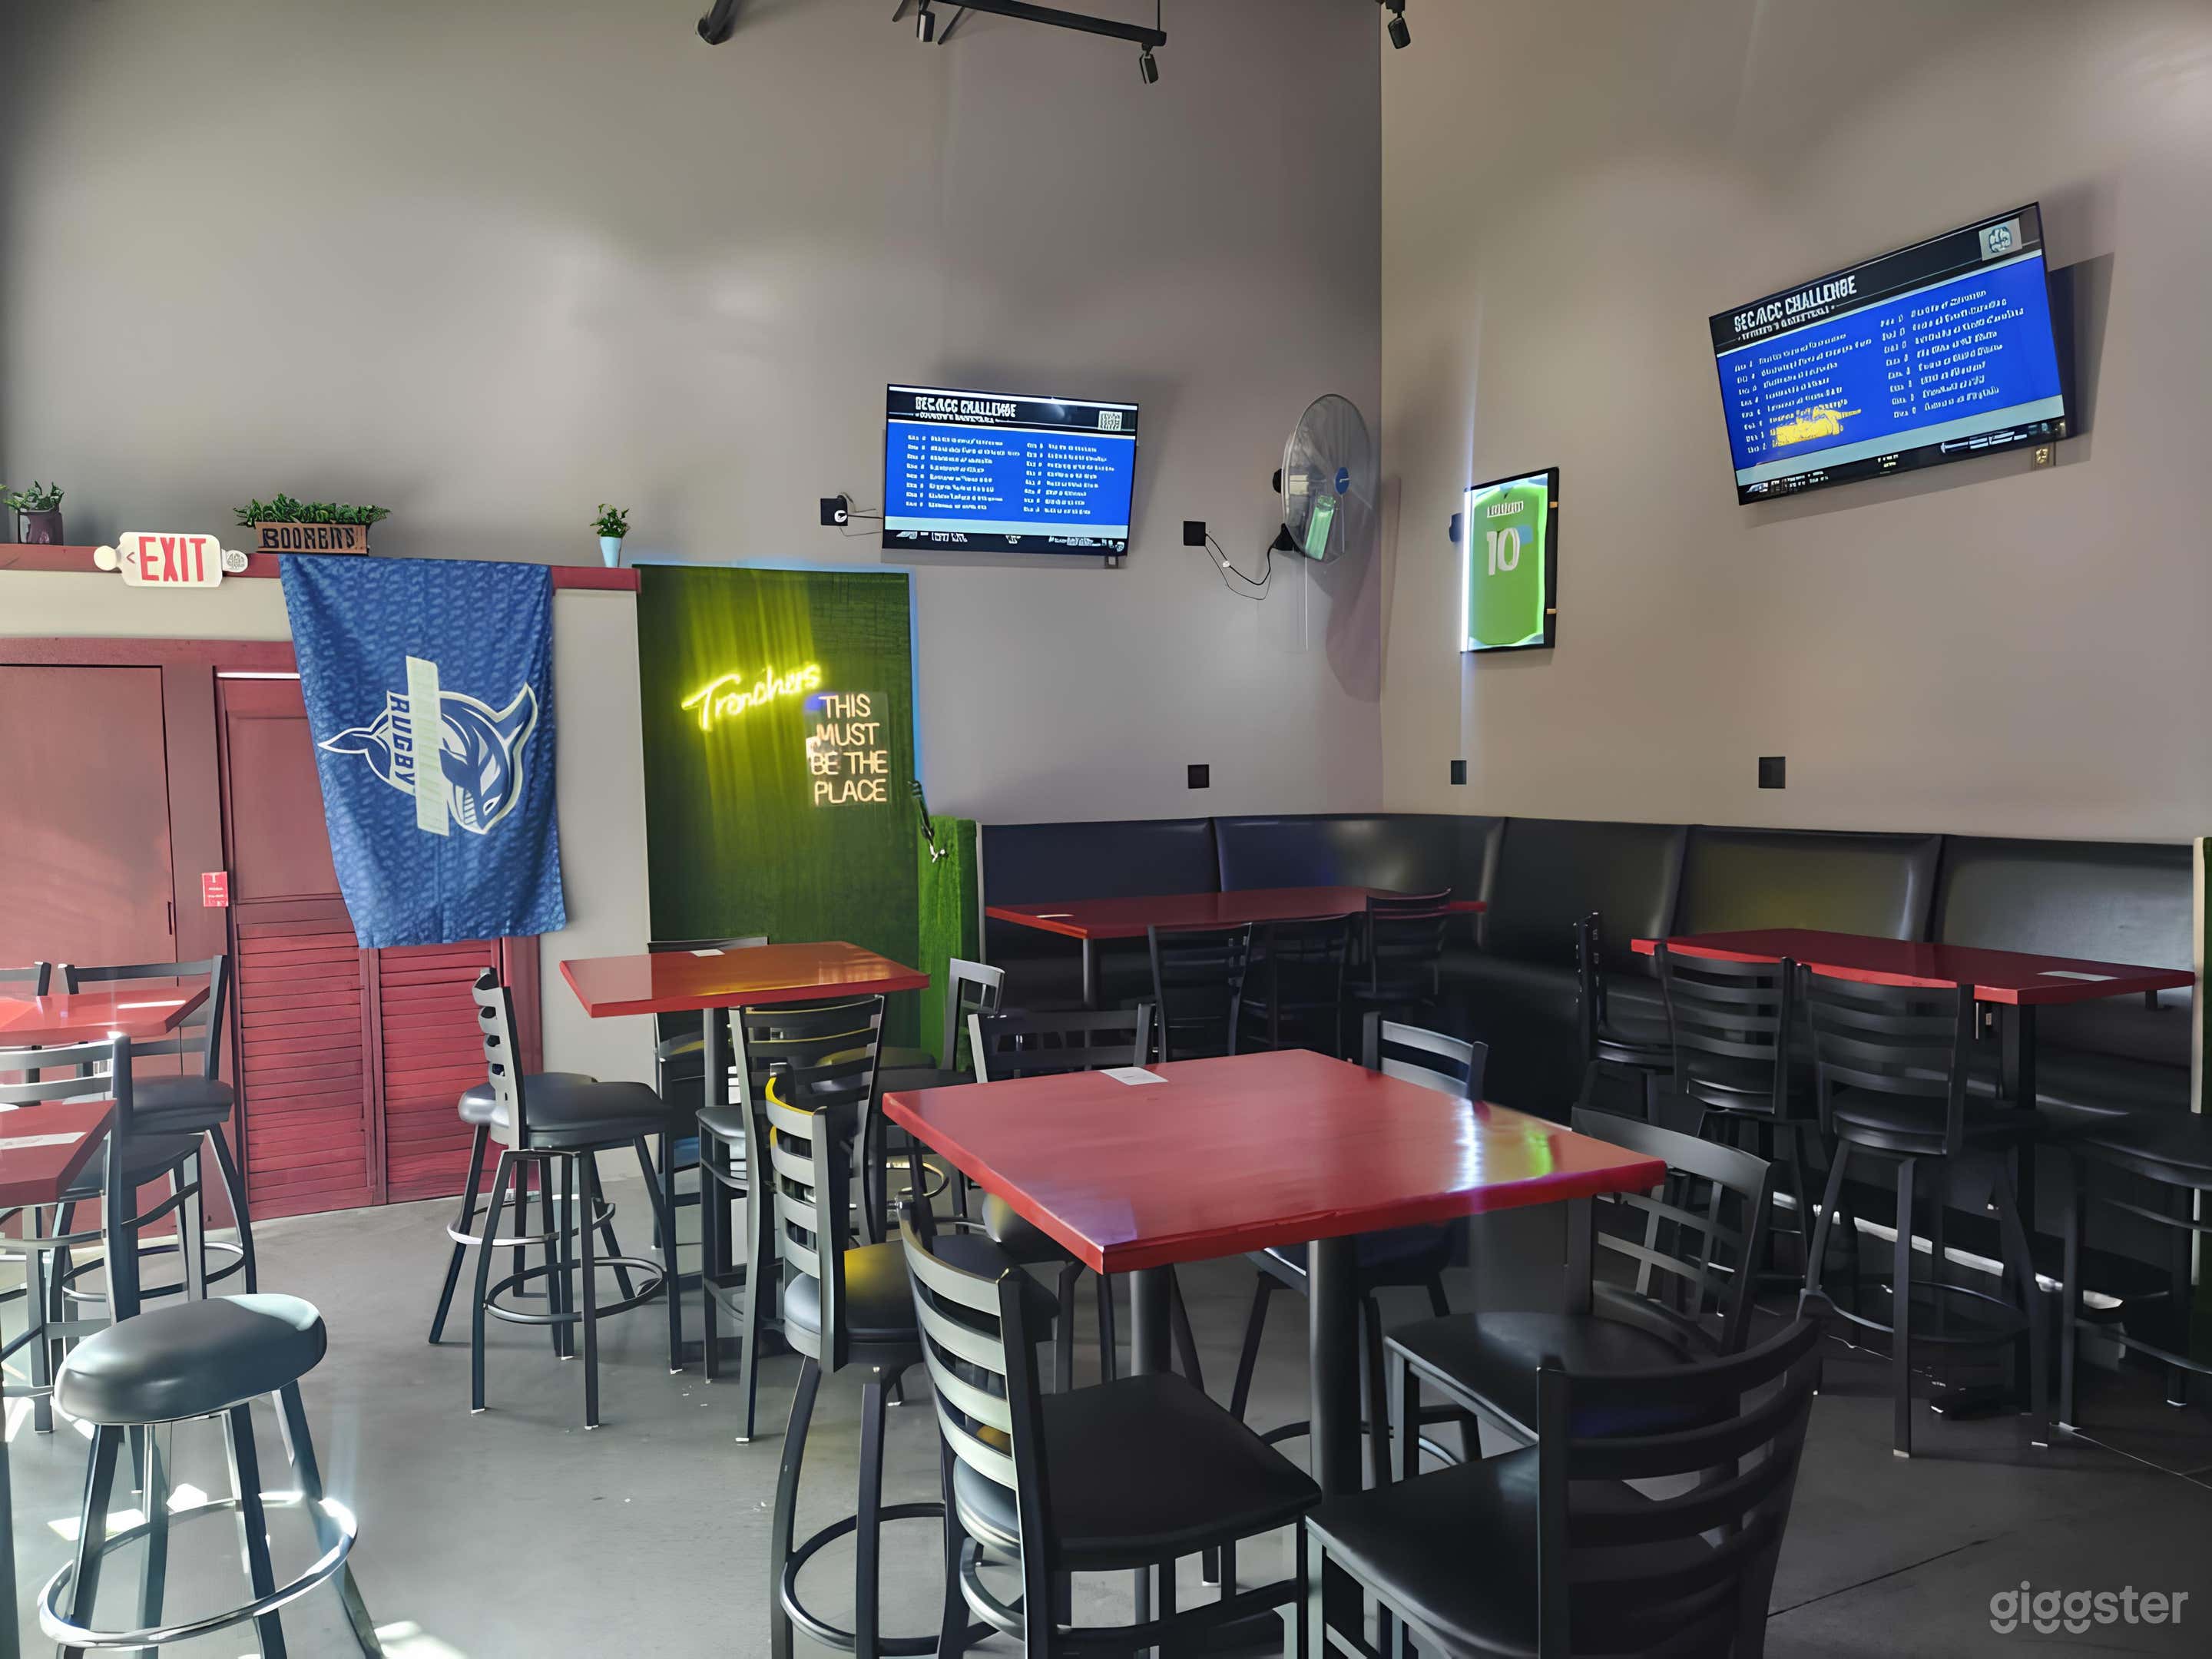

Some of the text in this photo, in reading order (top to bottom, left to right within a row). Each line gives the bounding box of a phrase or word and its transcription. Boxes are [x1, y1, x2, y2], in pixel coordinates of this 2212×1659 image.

[138, 536, 207, 582] EXIT
[1486, 526, 1521, 576] 10
[818, 694, 871, 719] THIS
[389, 694, 416, 786] RUGBY
[816, 722, 880, 747] MUST
[810, 750, 889, 776] BE THE
[814, 779, 887, 807] PLACE
